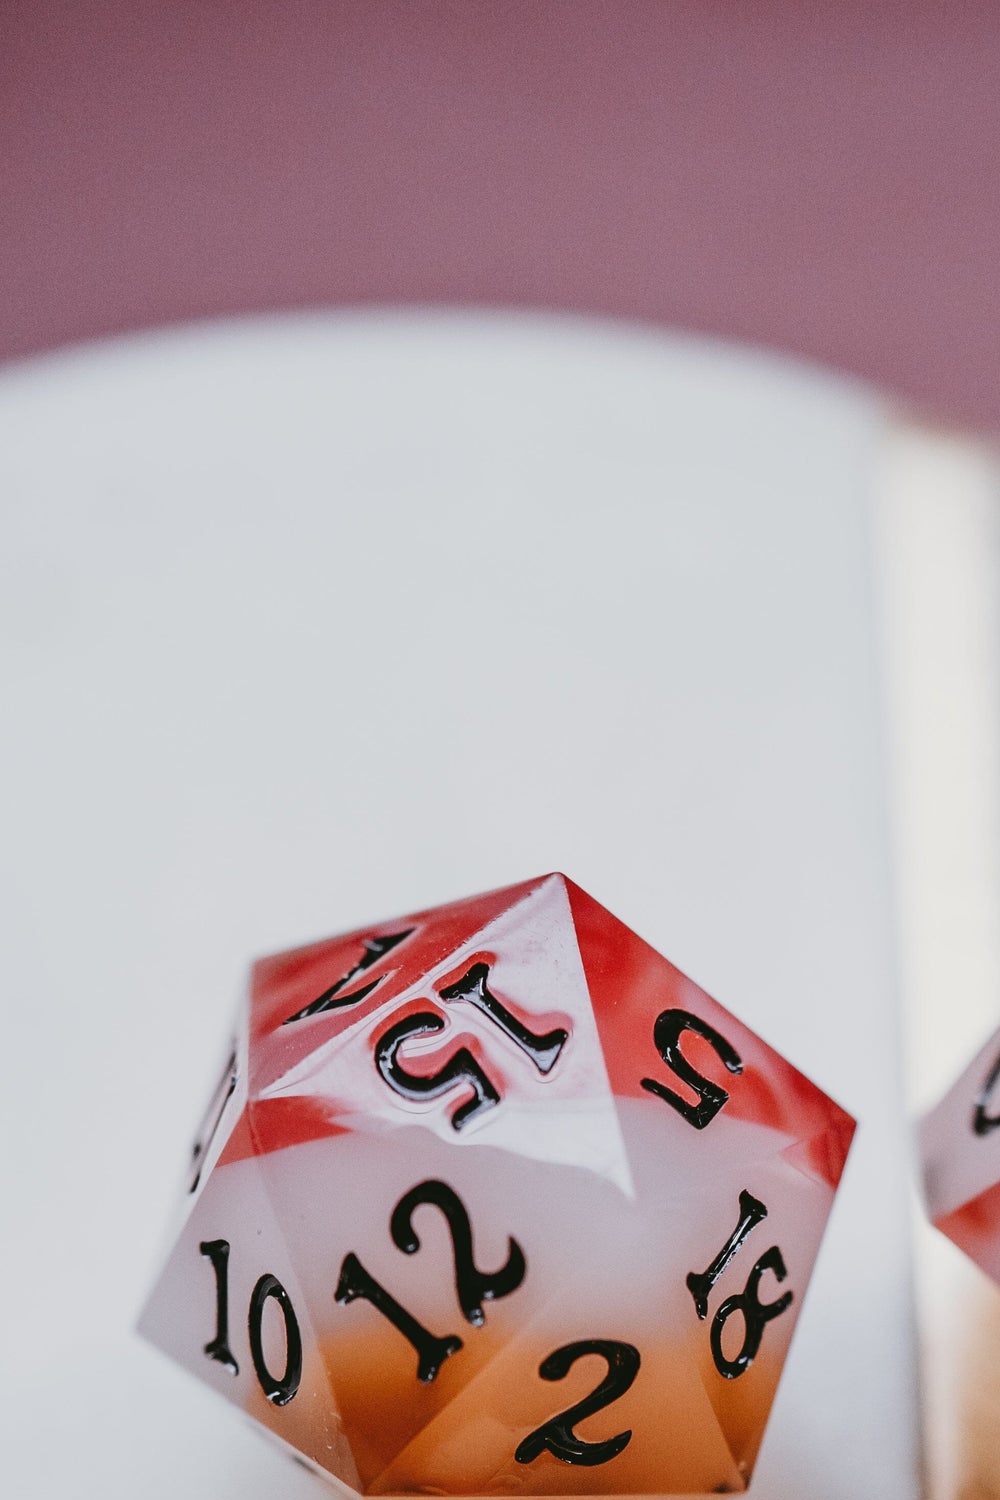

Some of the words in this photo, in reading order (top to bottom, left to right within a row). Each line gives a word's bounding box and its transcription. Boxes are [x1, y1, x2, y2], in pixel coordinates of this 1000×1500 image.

[374, 960, 569, 1132] 15
[639, 1007, 744, 1131] 5
[199, 1238, 304, 1407] 10
[333, 1179, 527, 1385] 12
[685, 1188, 794, 1380] 18
[513, 1338, 642, 1468] 2
